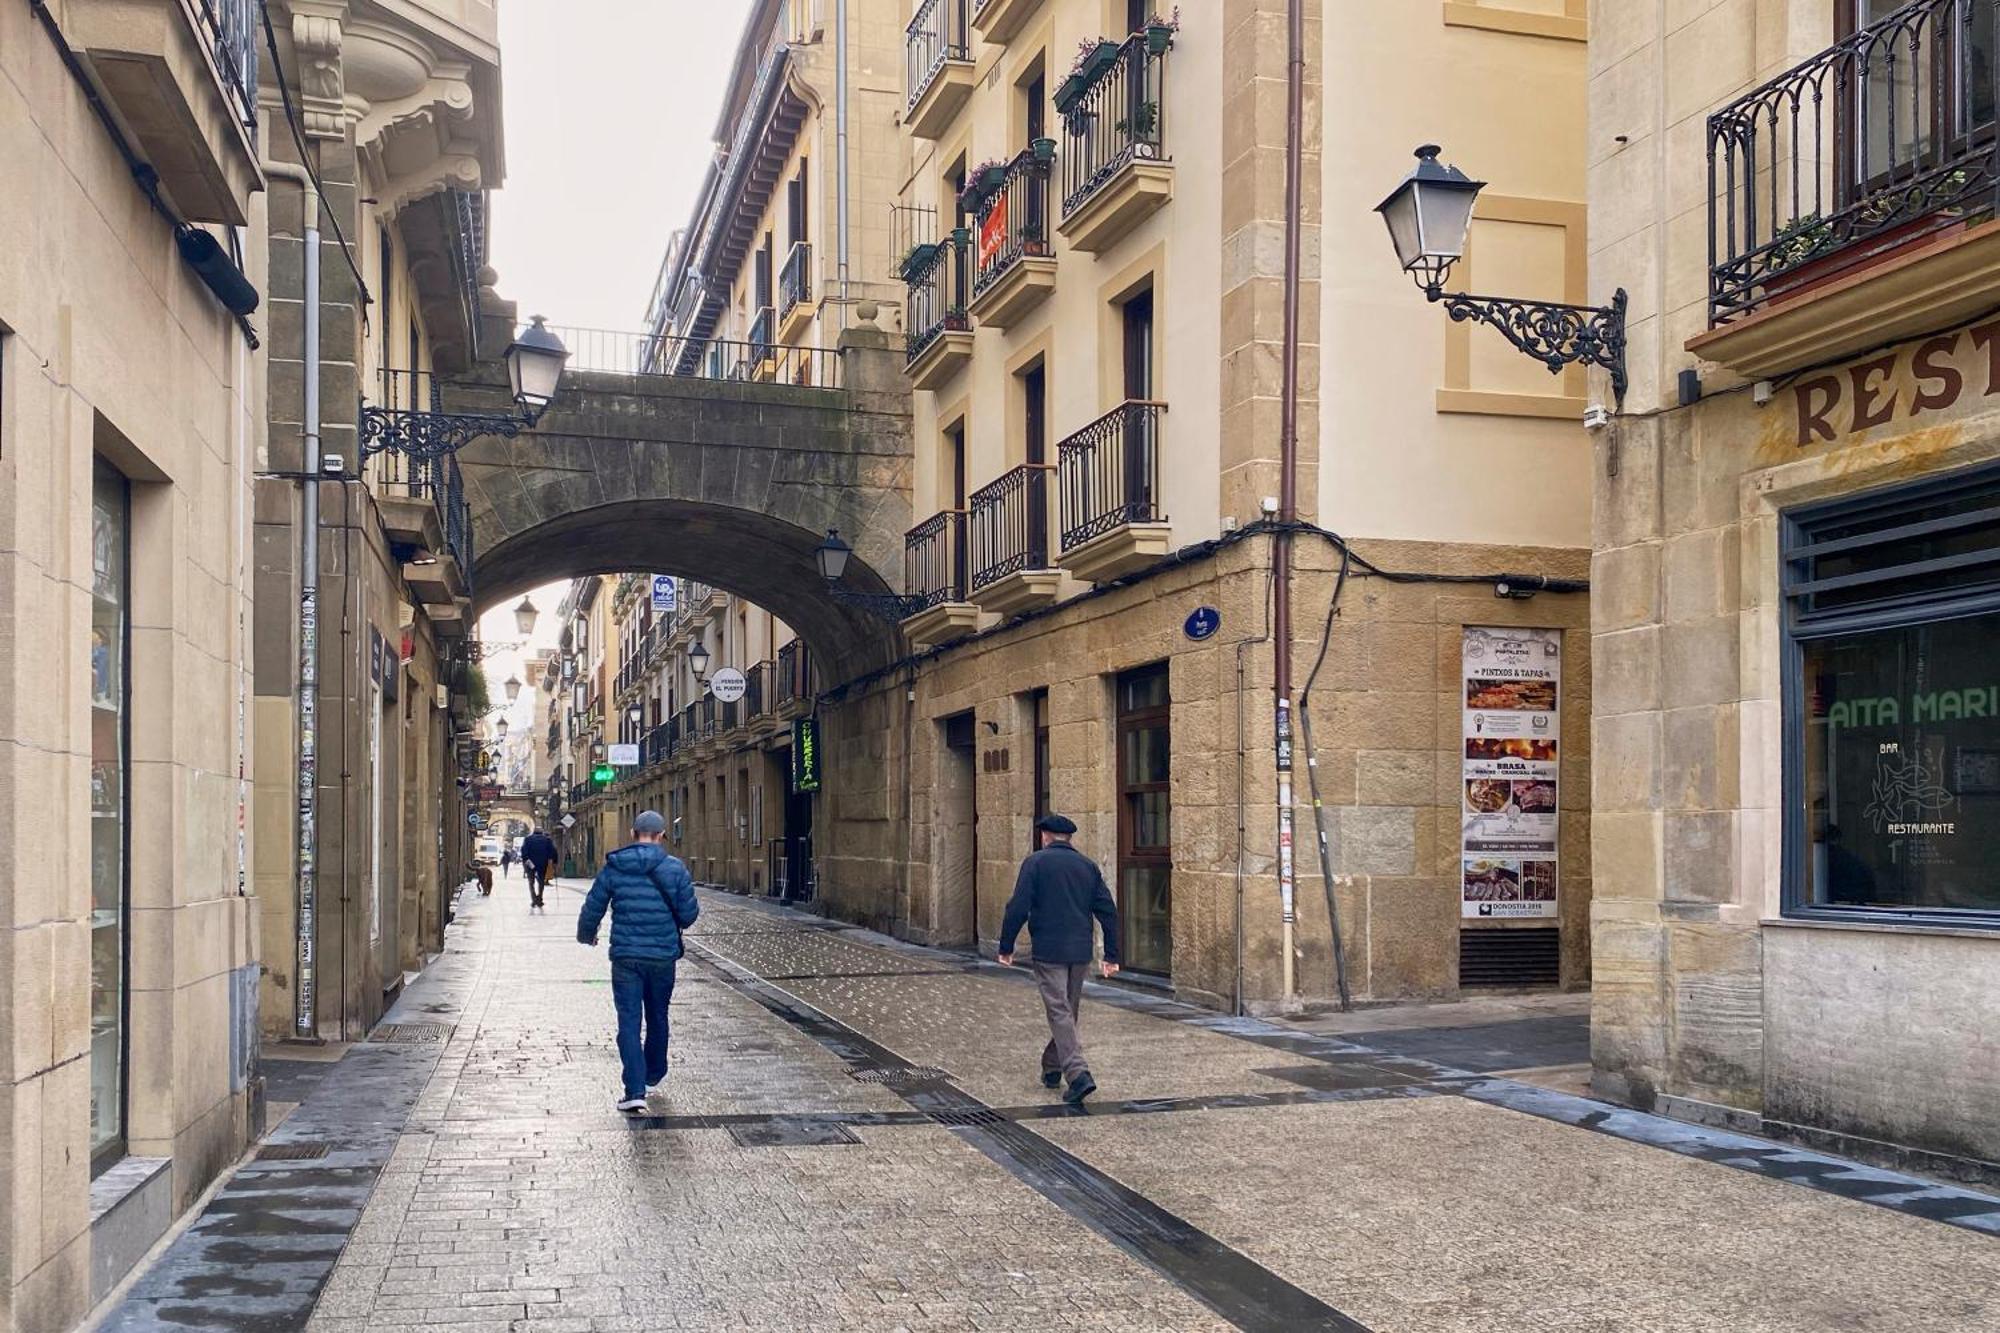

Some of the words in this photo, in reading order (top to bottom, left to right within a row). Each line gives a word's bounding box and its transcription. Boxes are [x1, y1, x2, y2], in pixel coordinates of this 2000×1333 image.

[1481, 668, 1513, 677] PINTXOS
[1514, 669, 1520, 677] &
[1521, 670, 1544, 678] TAPAS
[1828, 696, 1899, 729] AITA
[1912, 686, 1998, 723] MARI
[1879, 743, 1898, 754] BAR
[1887, 823, 1955, 834] RESTAURANTE
